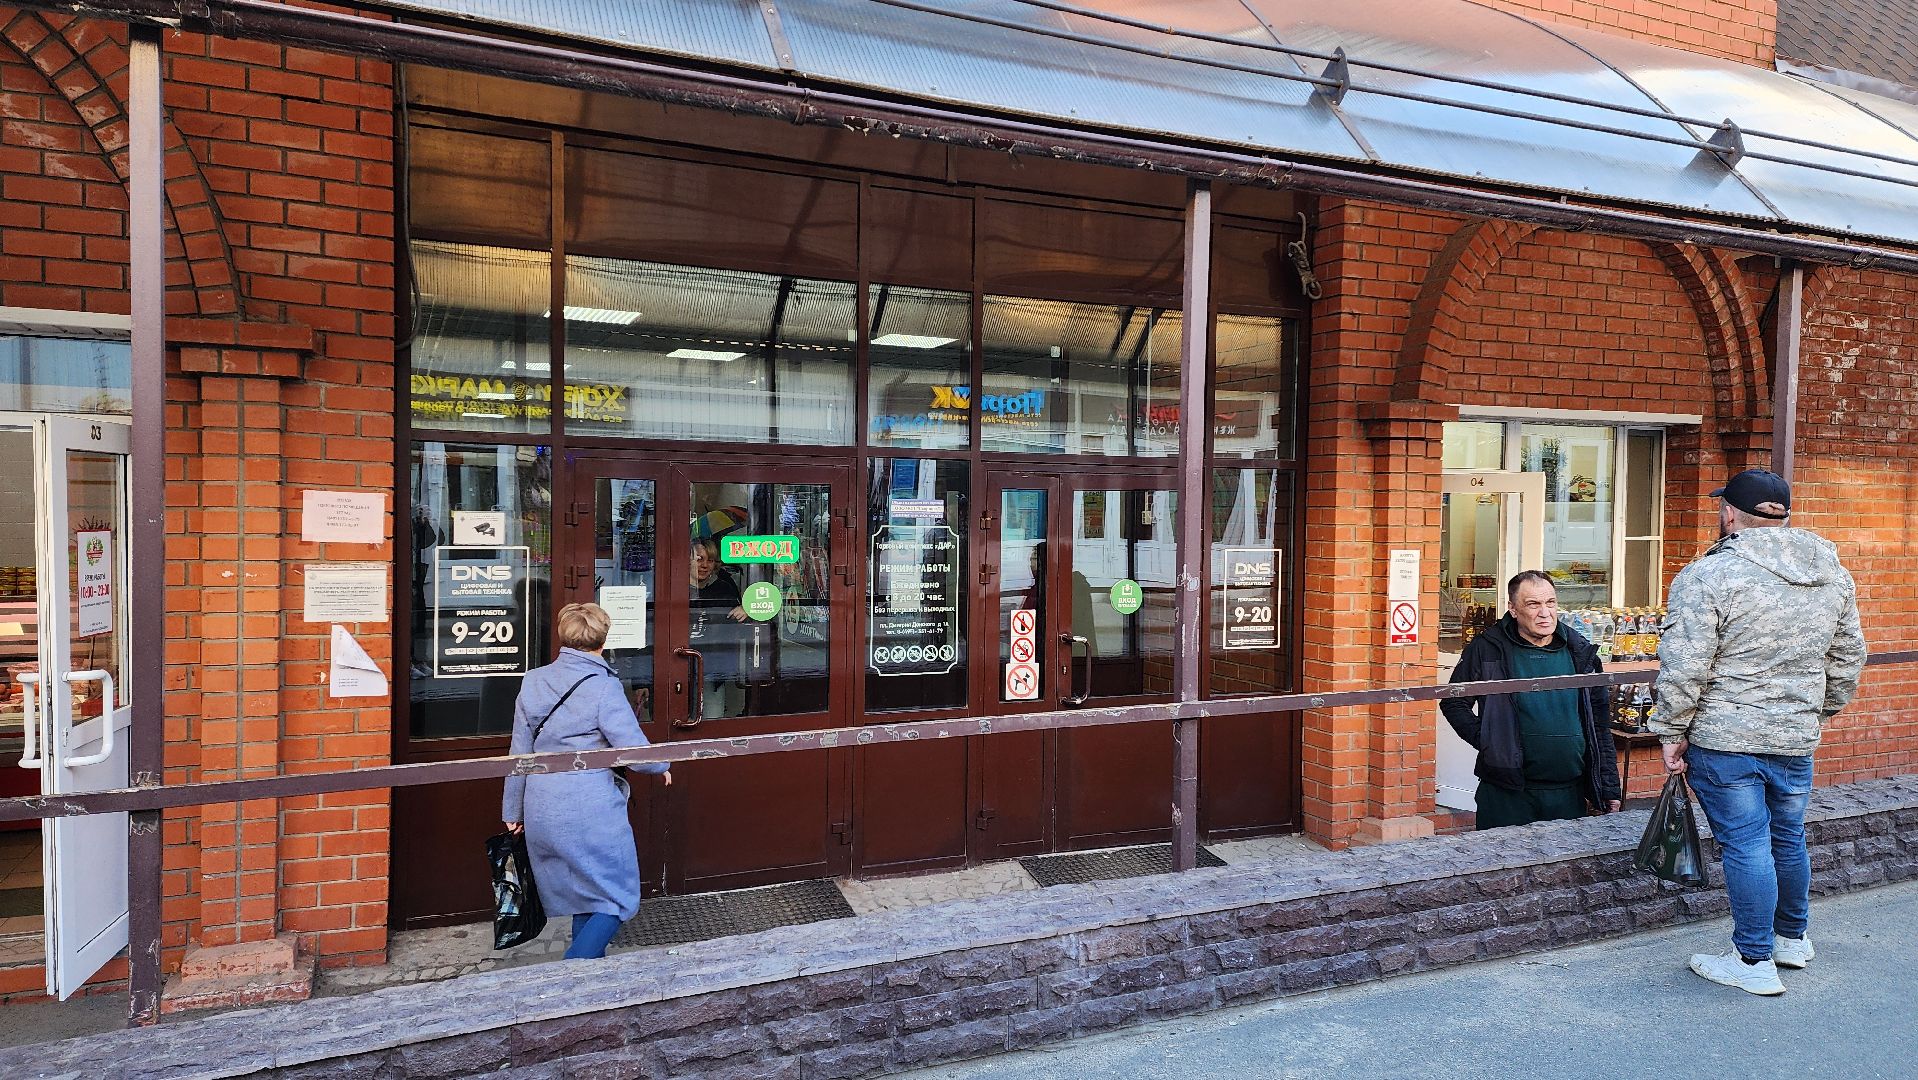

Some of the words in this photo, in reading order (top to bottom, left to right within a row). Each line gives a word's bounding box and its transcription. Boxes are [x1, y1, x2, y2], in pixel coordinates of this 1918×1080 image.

[1471, 477, 1484, 487] 04
[729, 541, 793, 560] ВХОД
[452, 566, 513, 581] DNS
[880, 564, 914, 573] РЕЖИМ
[916, 564, 950, 573] РАБОТЫ
[1235, 563, 1271, 575] DNS
[900, 594, 911, 602] до
[914, 592, 925, 600] 20
[751, 602, 774, 611] ВХОД
